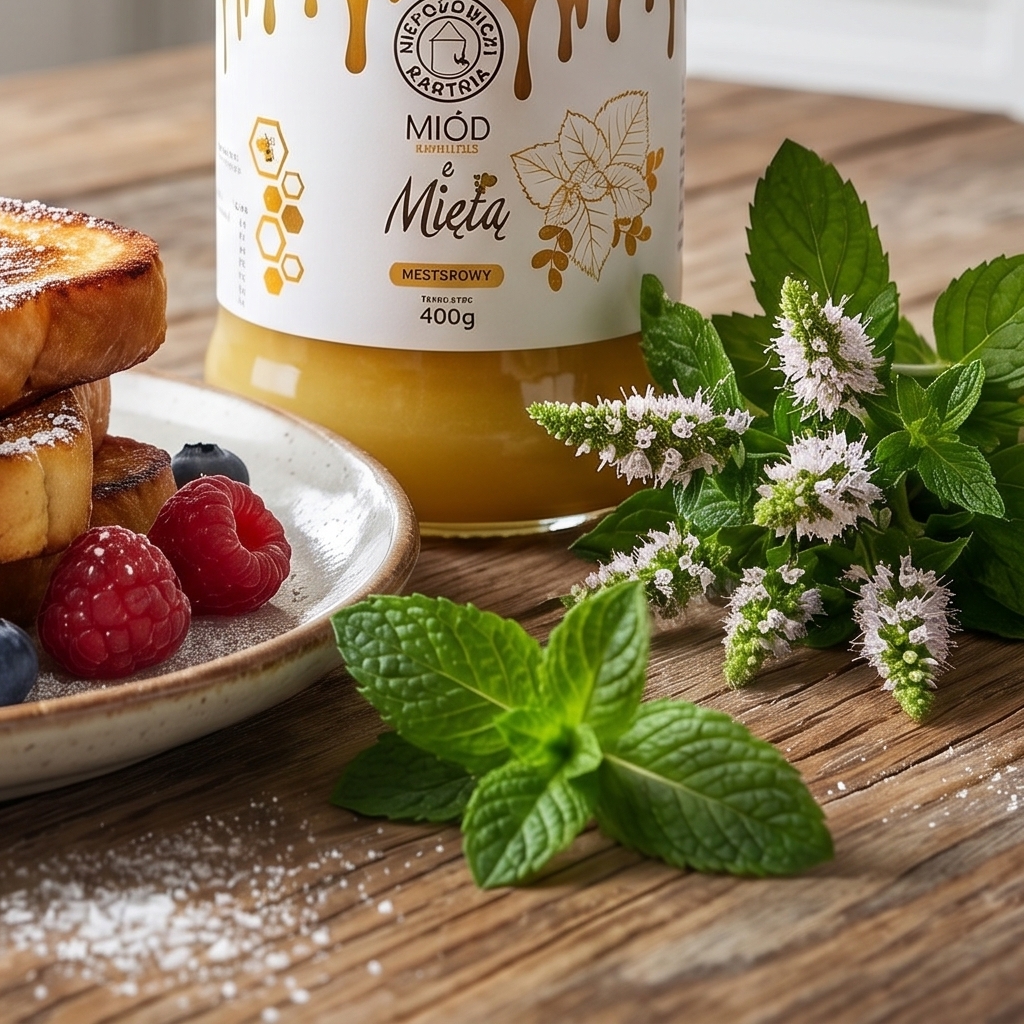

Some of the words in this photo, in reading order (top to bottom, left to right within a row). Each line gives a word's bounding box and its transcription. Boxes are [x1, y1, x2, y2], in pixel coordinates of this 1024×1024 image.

[406, 110, 491, 142] MIÓD
[402, 268, 492, 281] MESTSROWY
[420, 307, 475, 330] 400g
